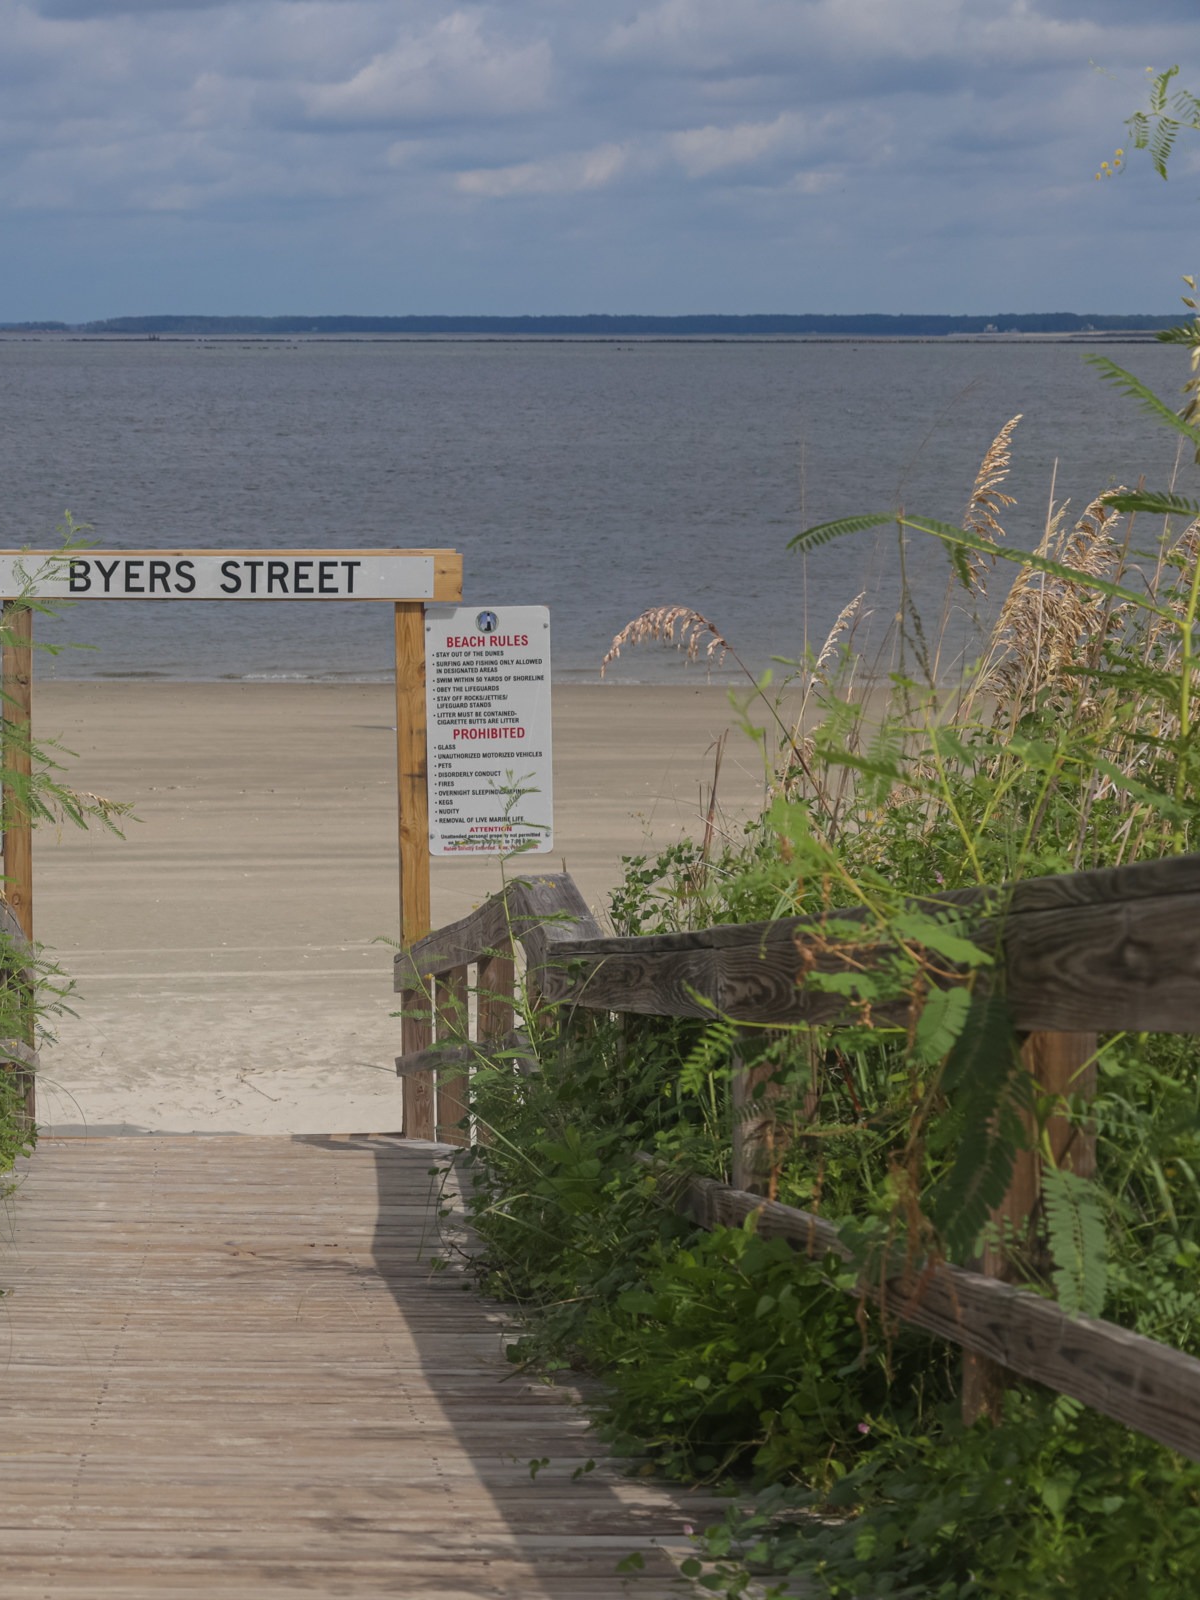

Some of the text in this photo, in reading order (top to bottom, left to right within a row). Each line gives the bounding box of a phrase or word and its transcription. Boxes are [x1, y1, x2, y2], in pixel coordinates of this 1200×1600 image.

[69, 560, 361, 593] BYERS STREET
[447, 635, 528, 648] BEACH RULES
[453, 728, 525, 739] PROHIBITED
